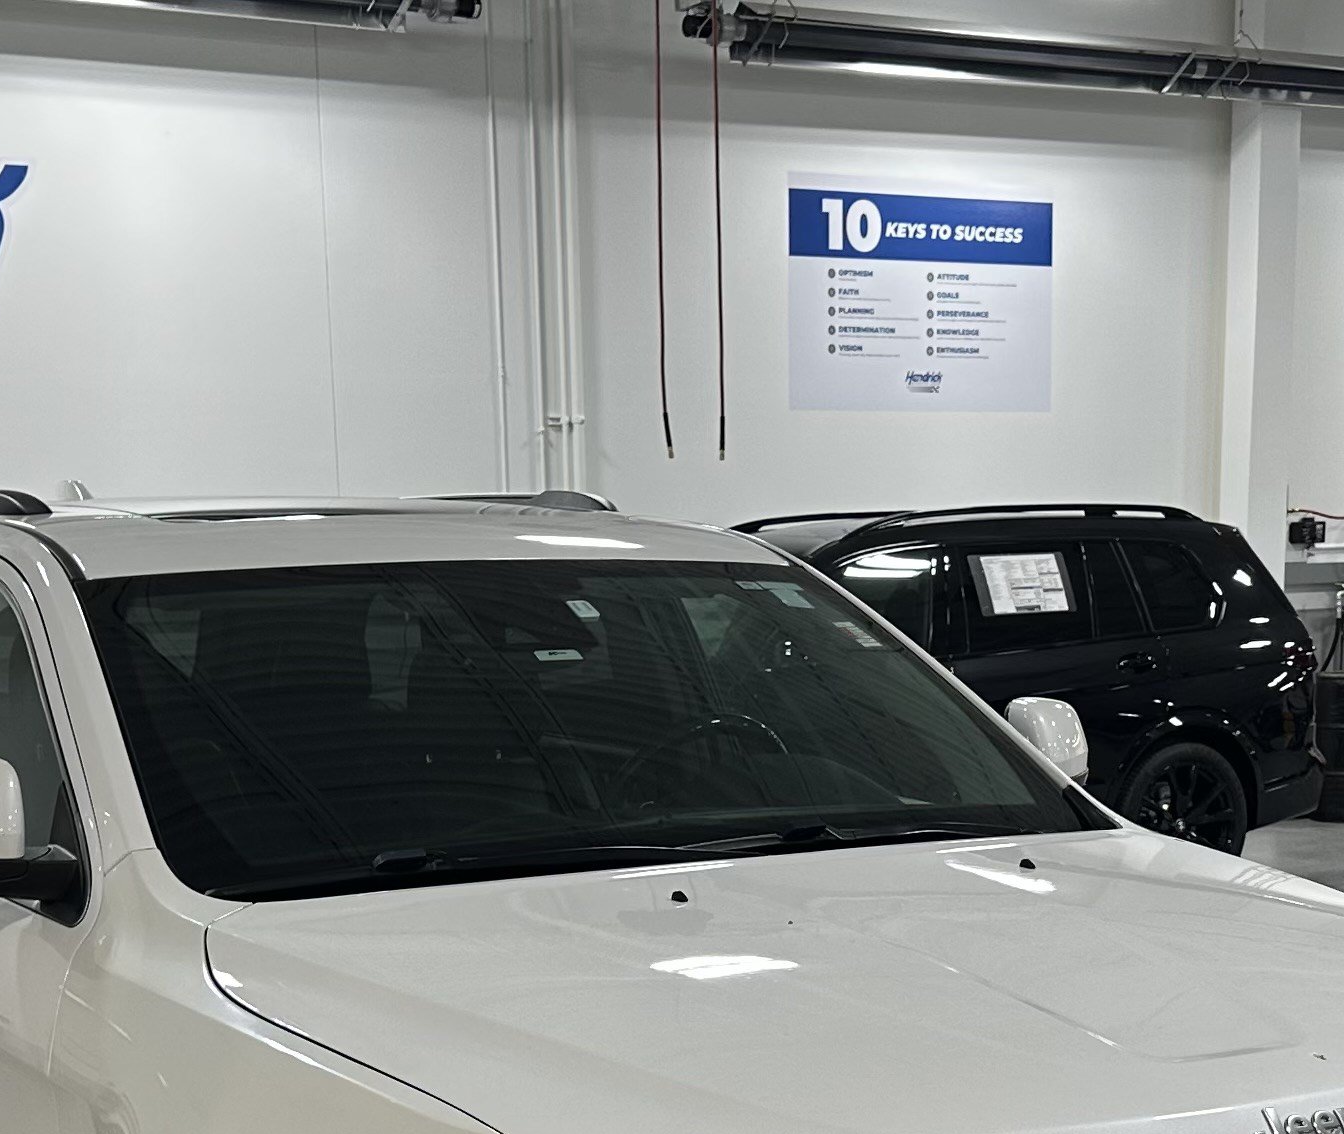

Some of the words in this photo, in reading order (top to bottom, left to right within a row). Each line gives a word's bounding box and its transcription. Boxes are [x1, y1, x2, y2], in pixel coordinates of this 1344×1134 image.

[822, 198, 882, 253] 10
[885, 222, 927, 240] KEYS
[930, 224, 952, 241] TO
[954, 225, 1024, 244] SUCCESS
[838, 288, 859, 296] FAITH
